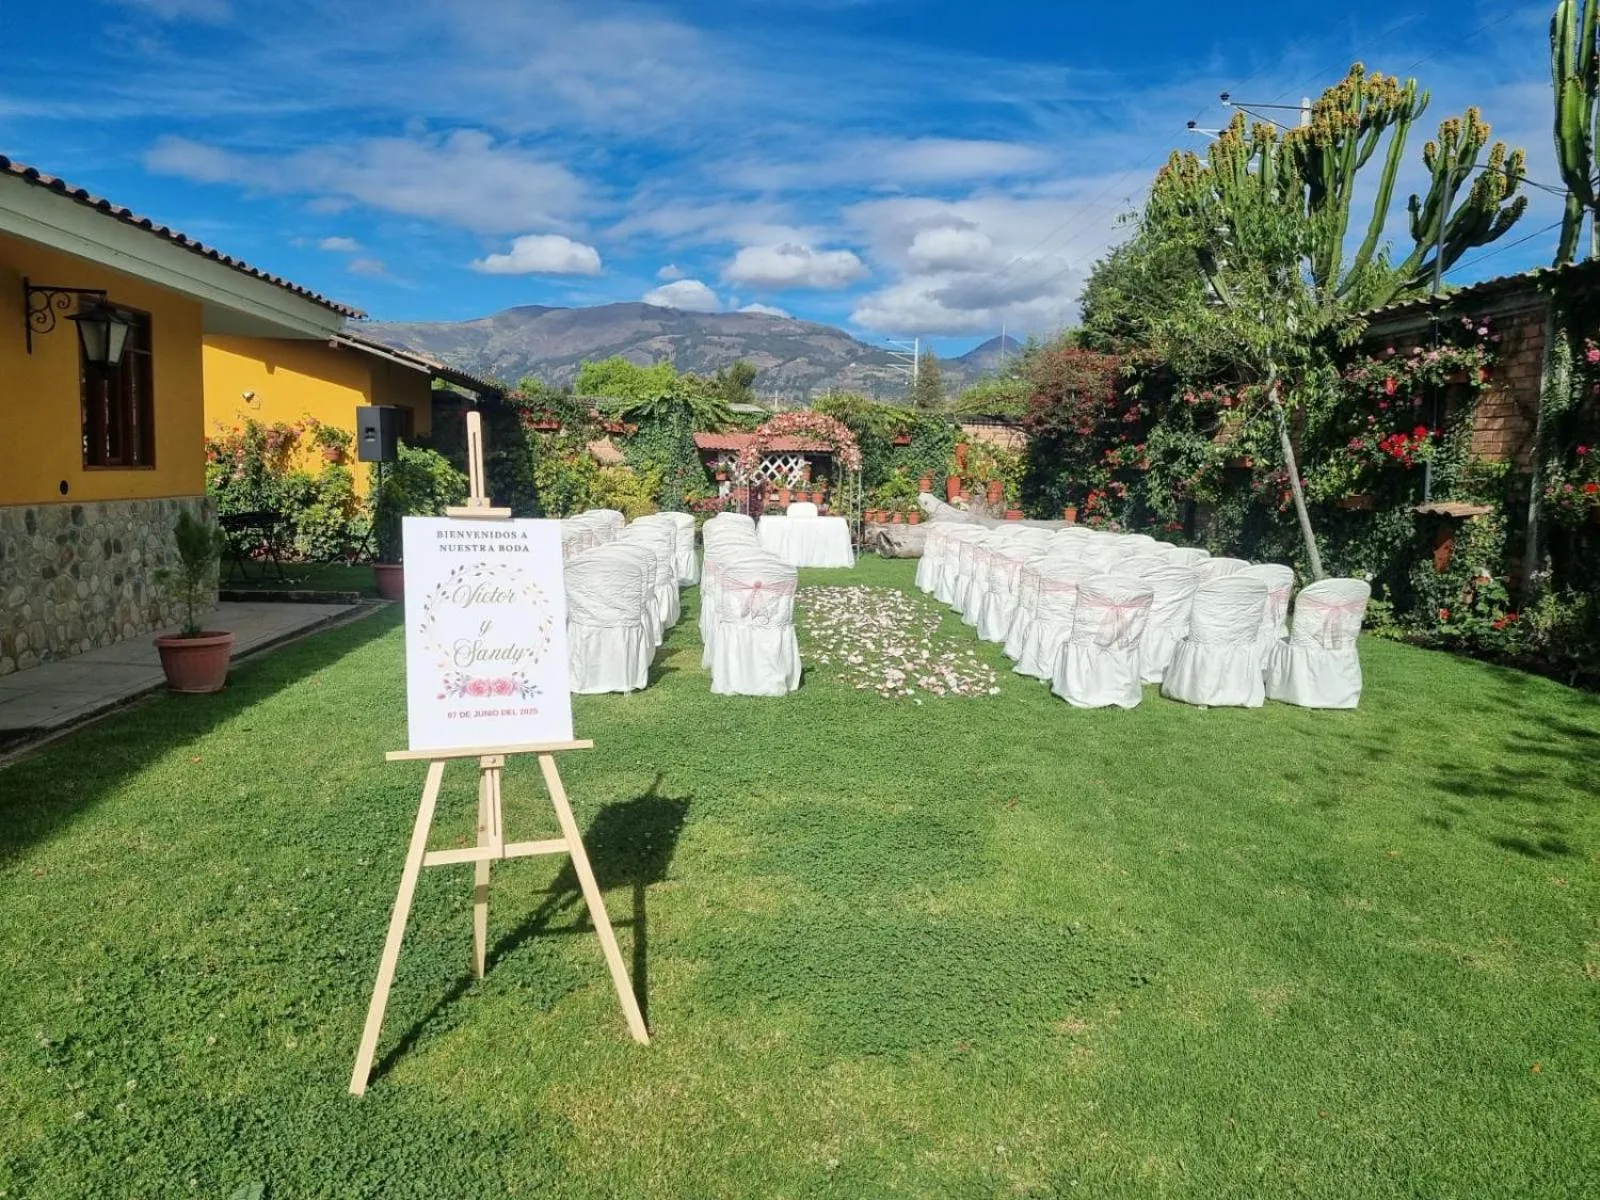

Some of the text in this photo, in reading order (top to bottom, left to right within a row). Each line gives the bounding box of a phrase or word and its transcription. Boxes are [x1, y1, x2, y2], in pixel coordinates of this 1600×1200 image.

[436, 530, 529, 539] BIENVENIDOS A
[439, 544, 530, 553] NUESTRA BODA
[452, 581, 516, 609] Victor
[478, 619, 492, 638] y
[453, 638, 525, 668] Sandy
[459, 711, 471, 719] DE
[473, 709, 499, 718] JUNIO
[501, 708, 518, 717] DEL
